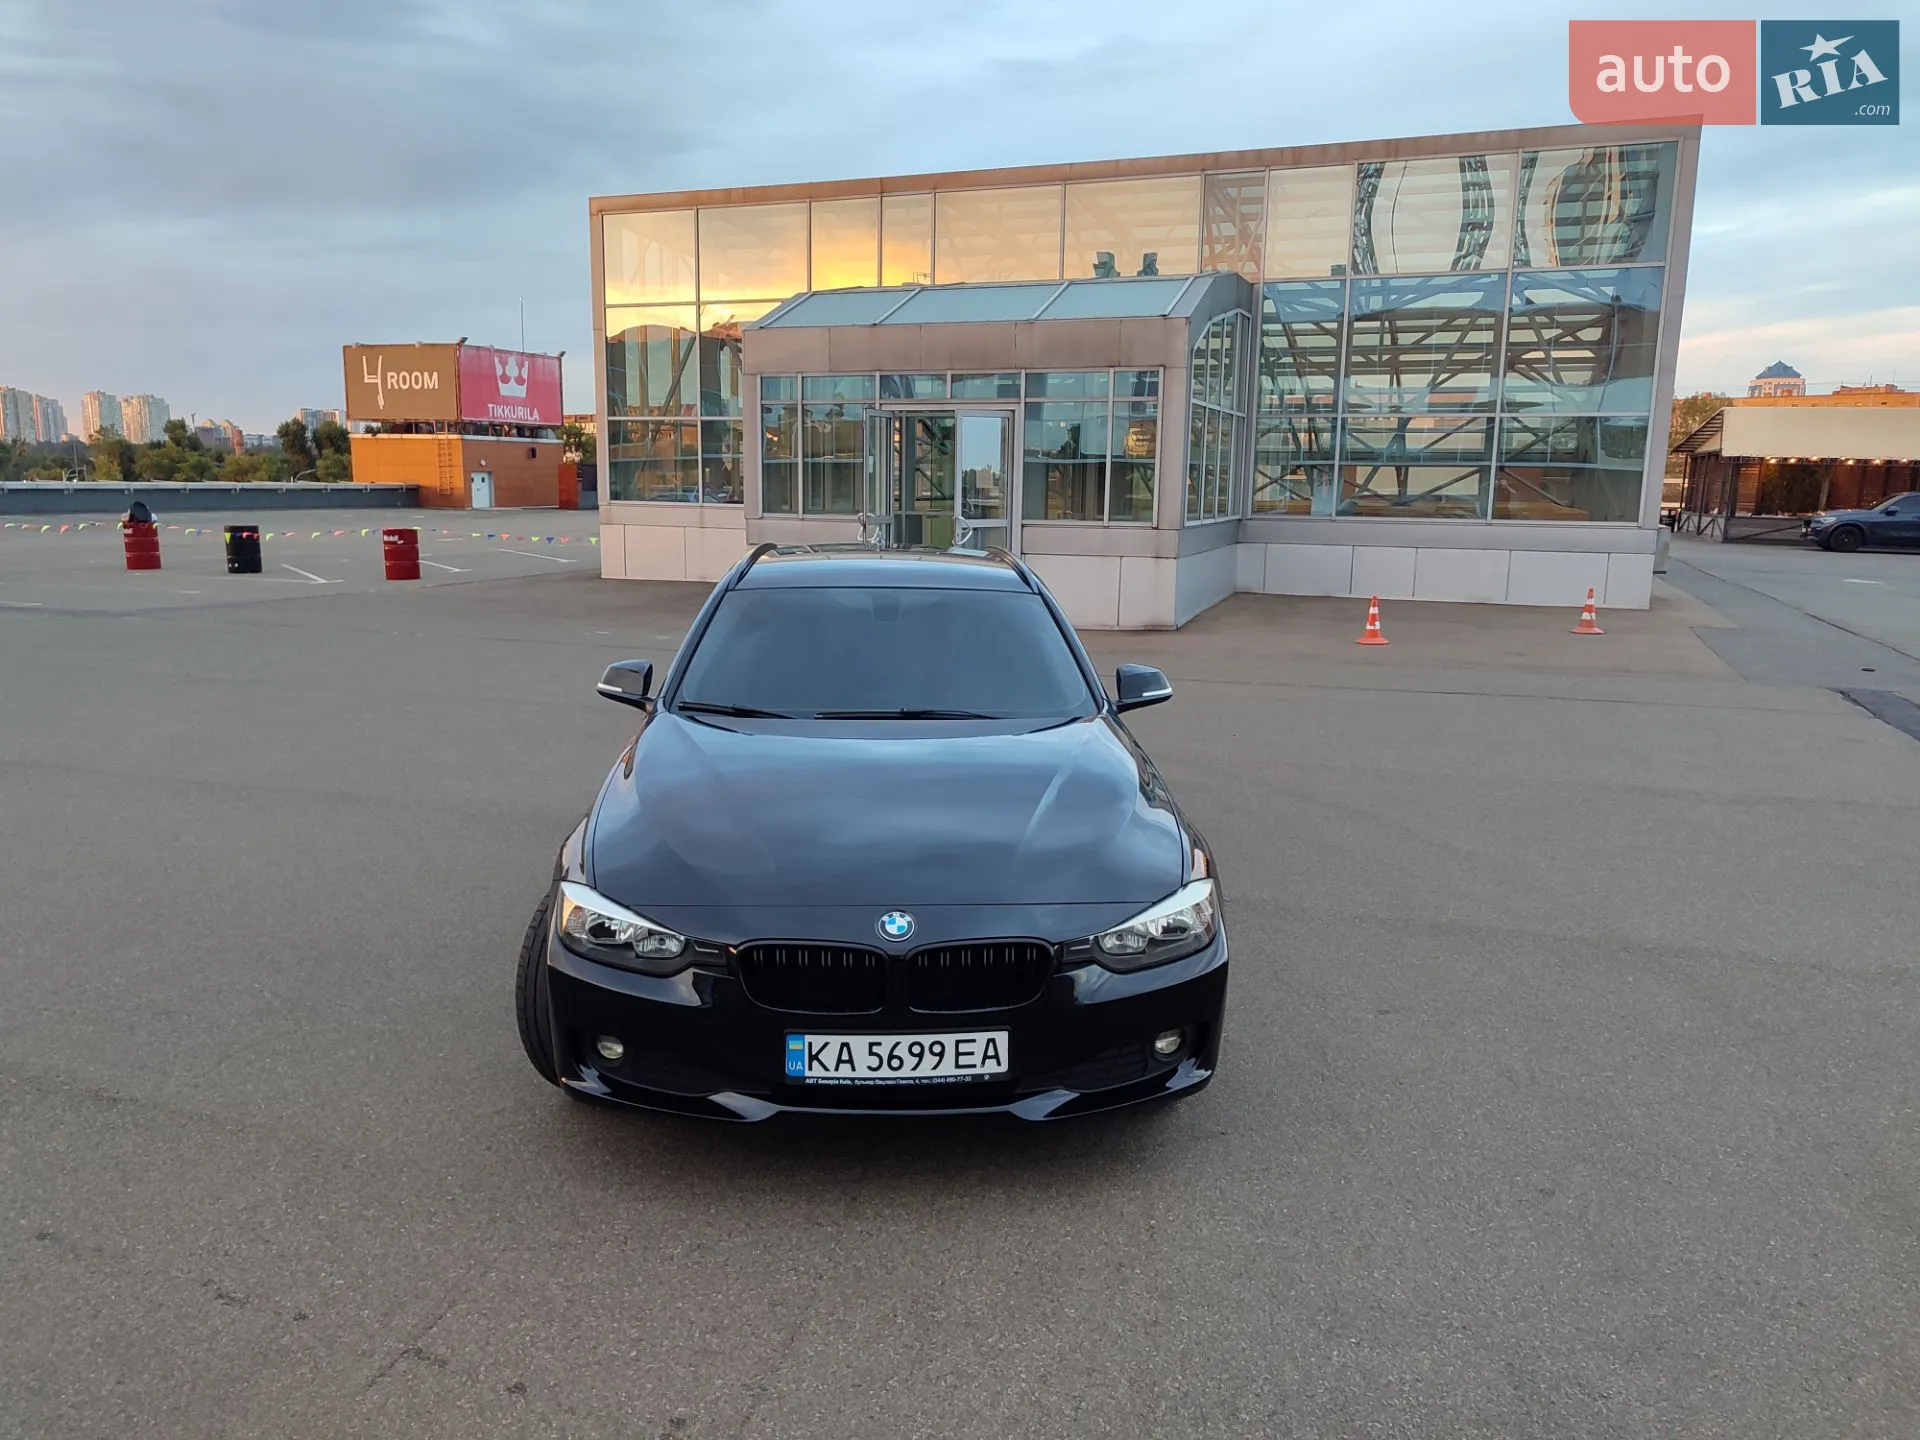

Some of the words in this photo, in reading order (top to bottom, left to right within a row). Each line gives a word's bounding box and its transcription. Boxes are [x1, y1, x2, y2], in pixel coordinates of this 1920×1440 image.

[386, 370, 439, 390] ROOM
[487, 403, 540, 421] TIKKURILA
[807, 1041, 856, 1072] KA
[866, 1040, 946, 1072] 5699
[954, 1037, 1002, 1069] EA
[788, 1061, 803, 1071] UA
